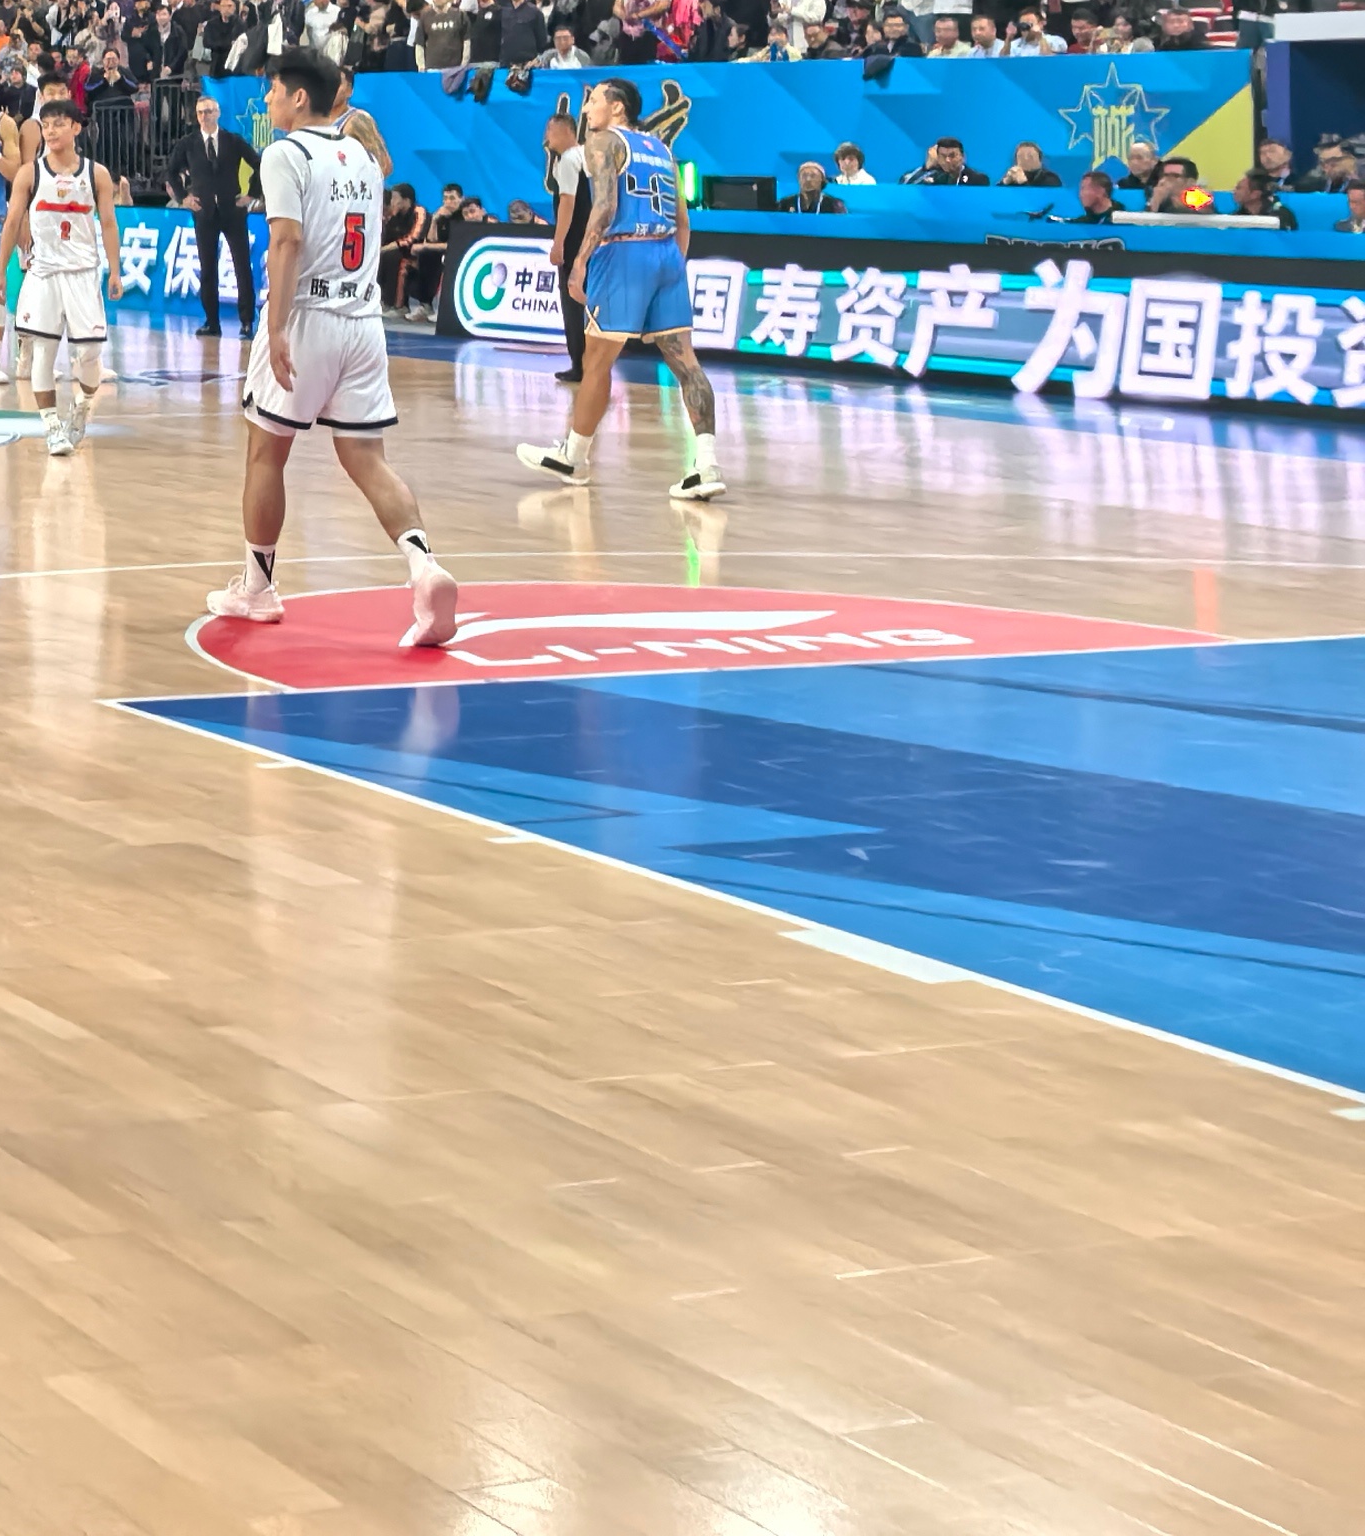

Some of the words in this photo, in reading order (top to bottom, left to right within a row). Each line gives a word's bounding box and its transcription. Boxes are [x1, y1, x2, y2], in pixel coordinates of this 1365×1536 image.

[60, 221, 72, 240] 2
[341, 212, 366, 272] 5
[515, 267, 557, 293] 中国
[512, 296, 558, 315] CHINA
[447, 627, 974, 667] LI-NING
